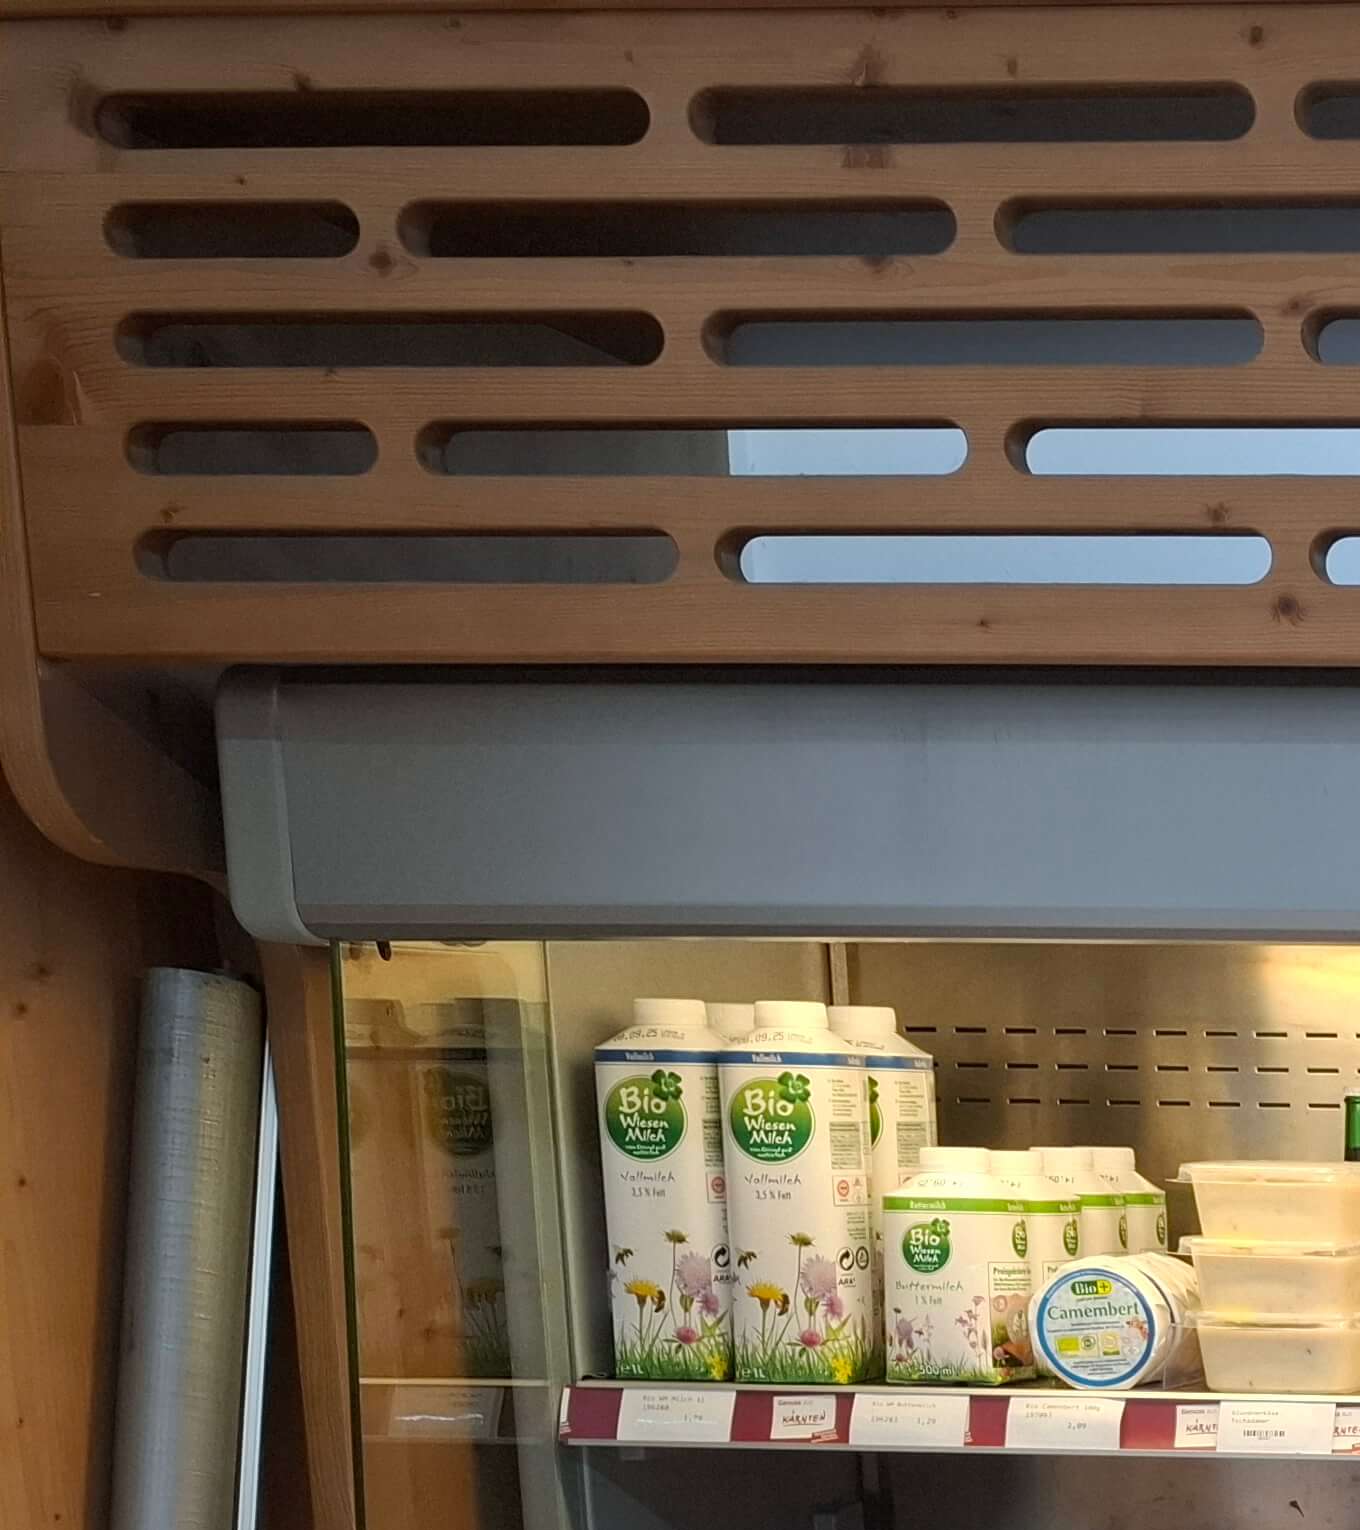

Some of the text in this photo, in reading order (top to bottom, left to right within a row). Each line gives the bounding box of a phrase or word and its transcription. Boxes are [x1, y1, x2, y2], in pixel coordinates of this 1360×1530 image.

[619, 1086, 667, 1115] Bio
[743, 1088, 795, 1117] Bio
[620, 1114, 669, 1129] Wiesen
[743, 1117, 797, 1131] Wiesen
[625, 1129, 667, 1142] Milch
[749, 1131, 793, 1145] Milch
[620, 1170, 676, 1184] Vollmilch
[744, 1173, 802, 1186] Vollmilch
[910, 1228, 941, 1246] Bio
[1047, 1301, 1140, 1320] Camembert
[1185, 1419, 1219, 1432] KÄRNT
